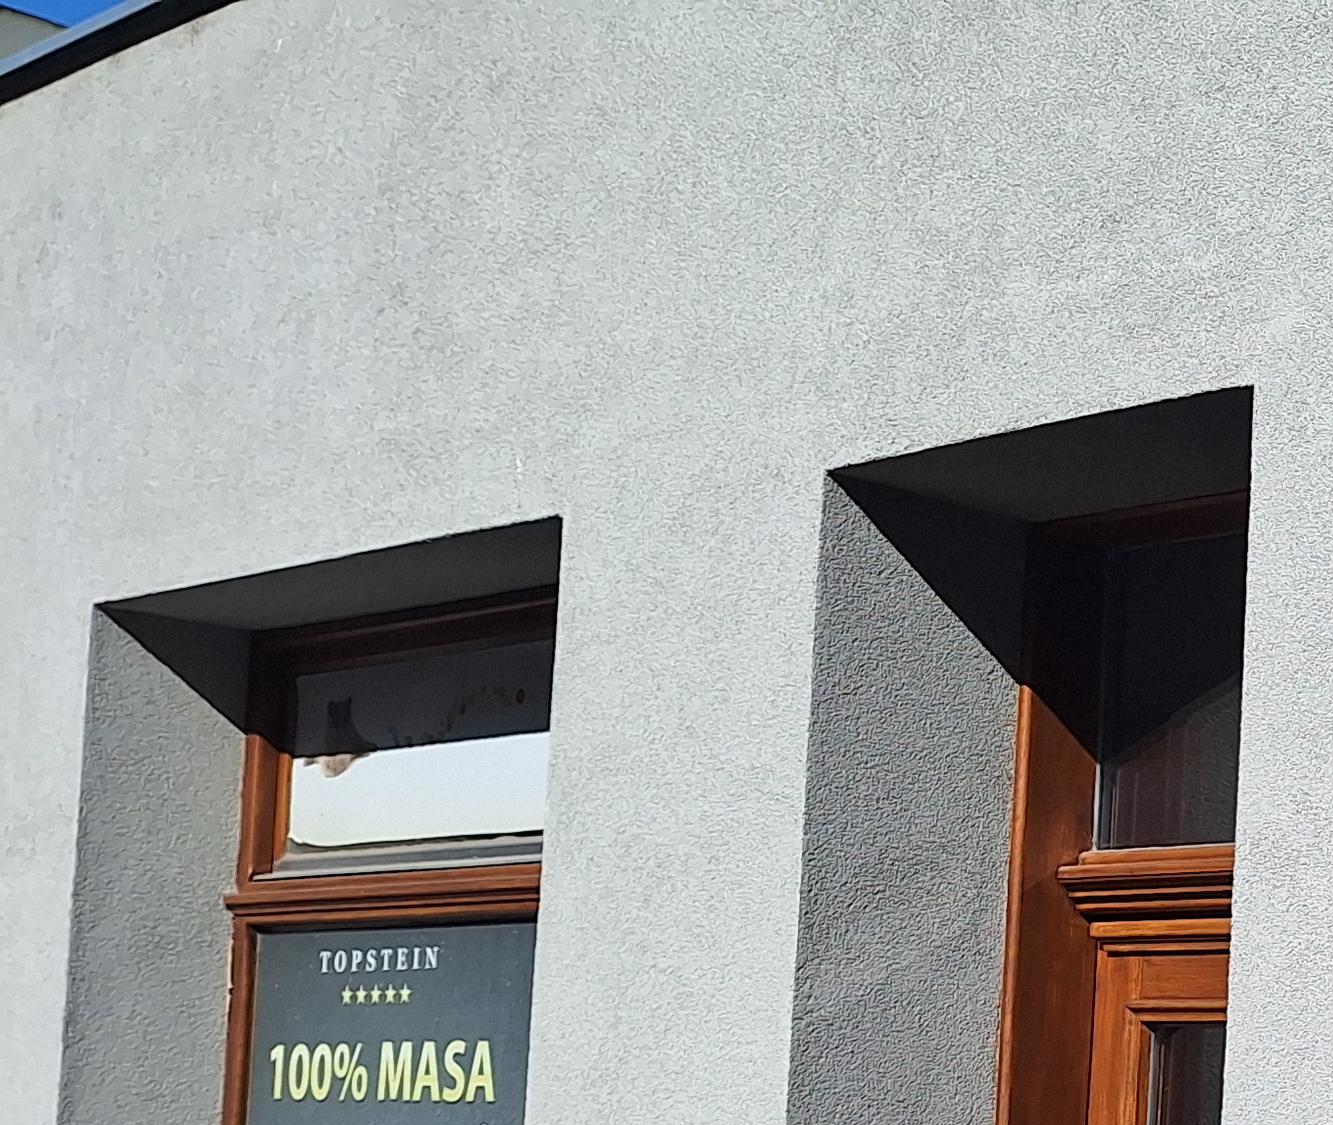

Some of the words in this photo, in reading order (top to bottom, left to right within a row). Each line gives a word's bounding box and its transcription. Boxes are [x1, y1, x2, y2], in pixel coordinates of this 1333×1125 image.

[318, 946, 440, 974] TOPSTEIN
[270, 1041, 368, 1101] 100%
[376, 1039, 496, 1103] MASA
